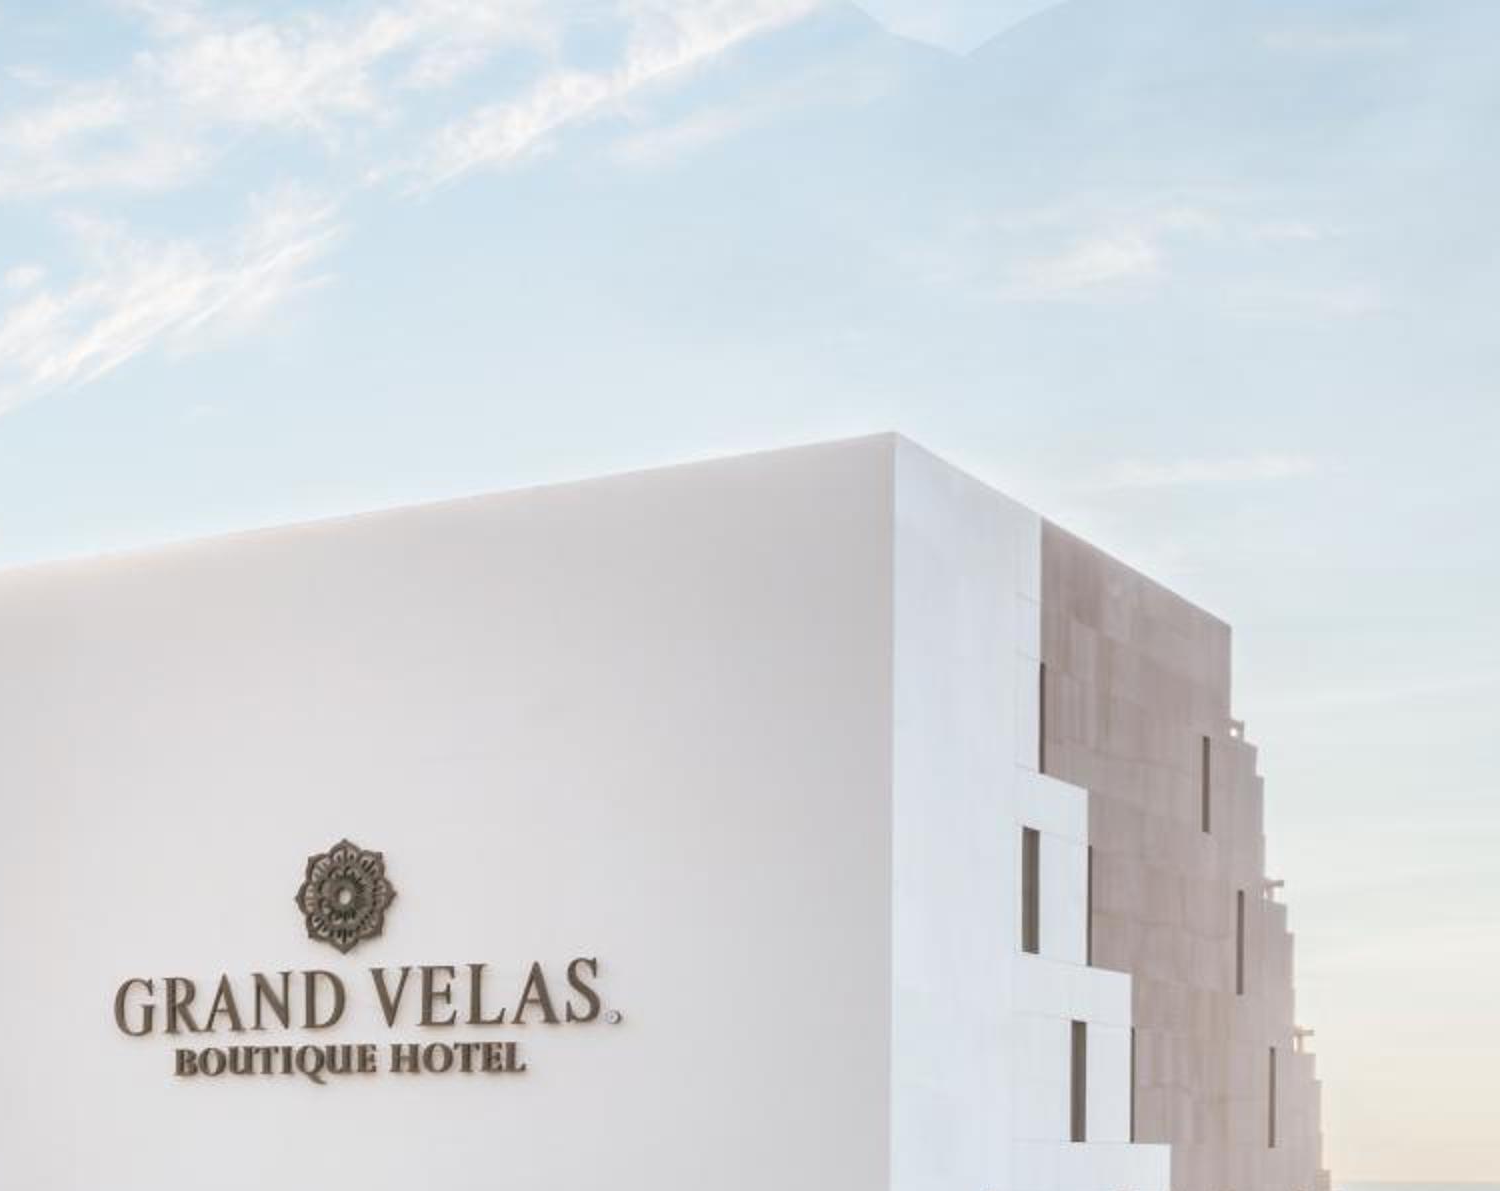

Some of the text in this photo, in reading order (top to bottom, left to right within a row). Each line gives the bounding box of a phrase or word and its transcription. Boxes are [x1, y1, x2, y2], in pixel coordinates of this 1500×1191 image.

[112, 969, 348, 1038] GRAND
[174, 1041, 528, 1086] BOUTIQUE HOTEL
